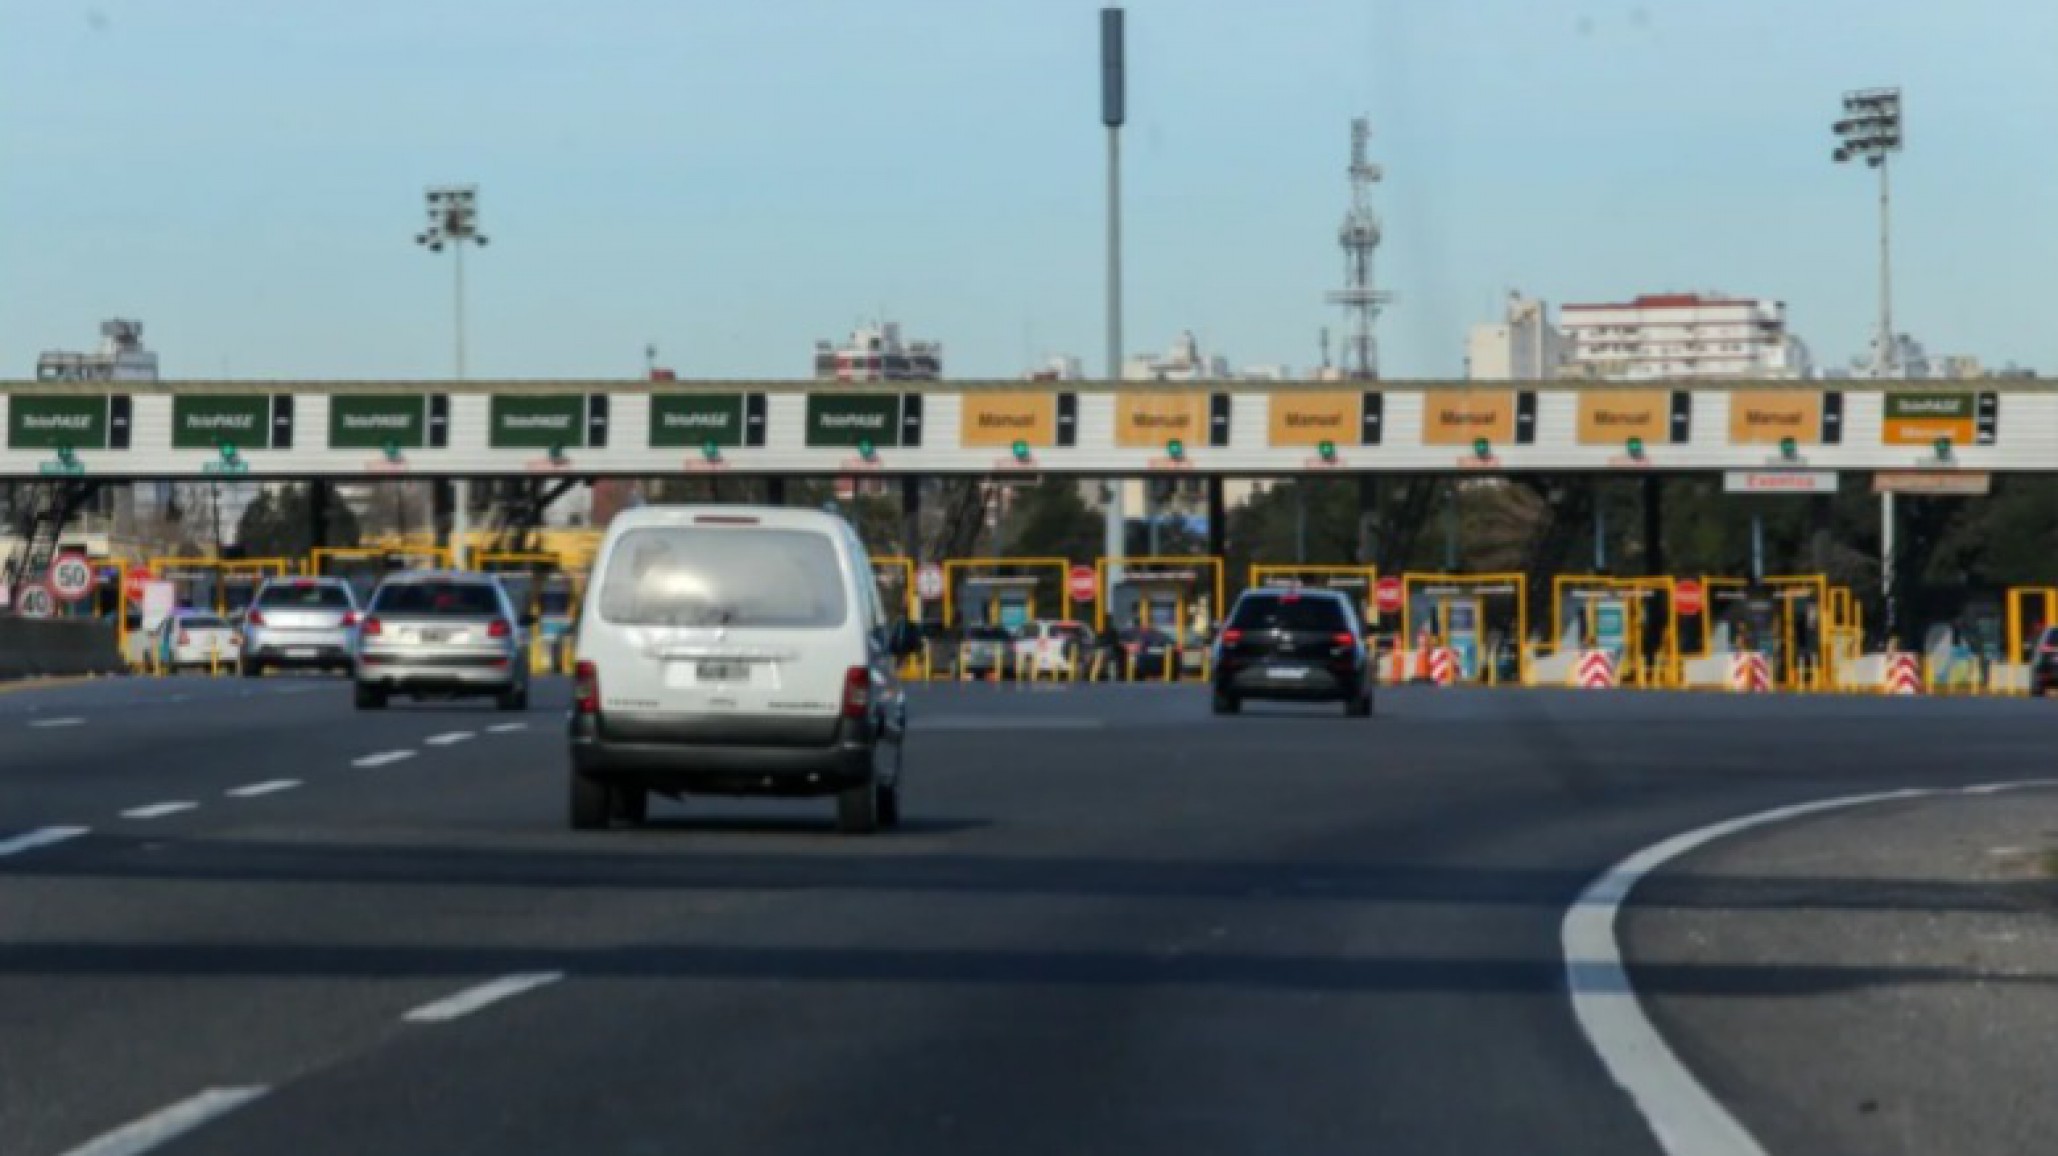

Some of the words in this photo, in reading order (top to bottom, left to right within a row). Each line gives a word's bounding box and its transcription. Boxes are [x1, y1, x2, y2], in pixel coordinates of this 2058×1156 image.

[978, 411, 1035, 428] Manual
[1132, 411, 1190, 428] Manual
[1285, 411, 1342, 427] Manual
[1440, 409, 1497, 425] Manual
[1593, 409, 1650, 425] Manual
[1746, 409, 1802, 425] Manual
[57, 563, 86, 588] 50
[23, 590, 49, 613] 40
